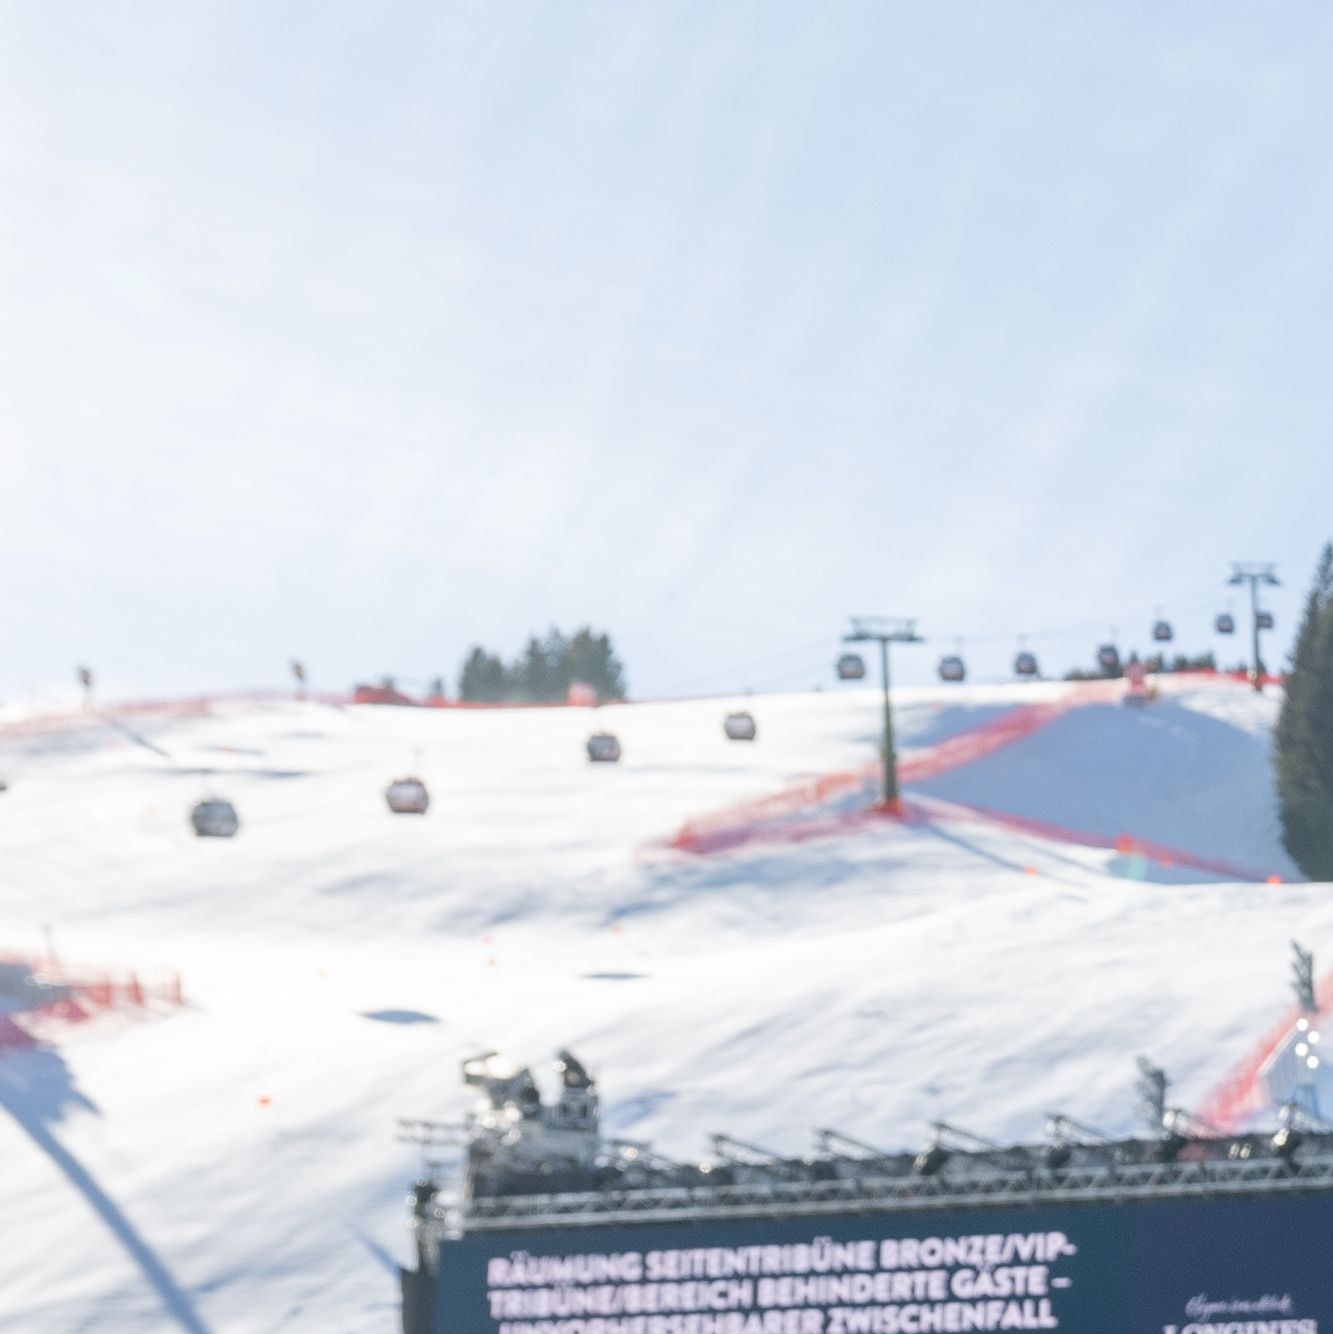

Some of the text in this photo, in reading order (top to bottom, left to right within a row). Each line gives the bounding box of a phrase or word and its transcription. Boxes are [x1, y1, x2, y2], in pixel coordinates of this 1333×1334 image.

[487, 1250, 642, 1287] RÄUMUNG
[645, 1236, 877, 1281] SEITENTRIBÜNE
[757, 1269, 948, 1307] BEHINDERTE
[951, 1262, 1048, 1298] GÄSTE
